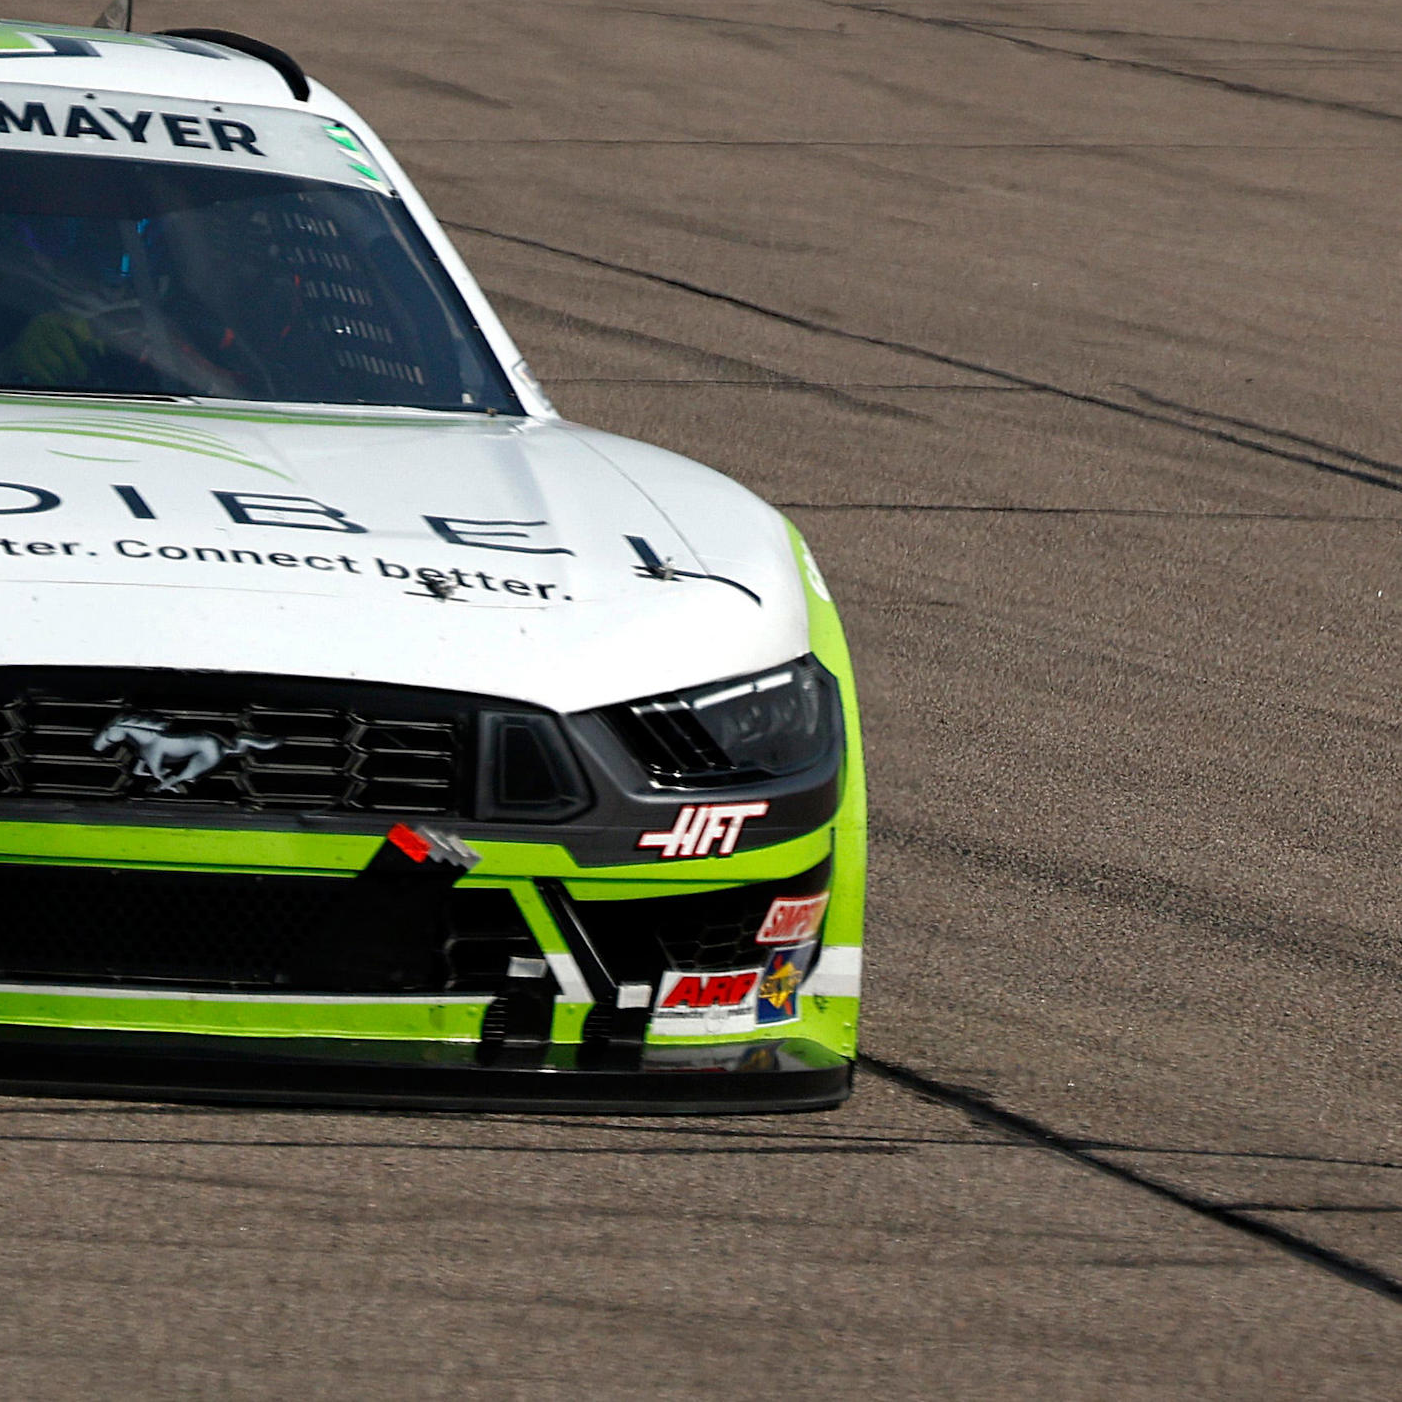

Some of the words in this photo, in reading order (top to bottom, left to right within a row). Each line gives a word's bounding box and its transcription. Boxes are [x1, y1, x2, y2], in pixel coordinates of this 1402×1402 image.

[113, 537, 362, 575] Connect
[374, 554, 574, 601] better.
[637, 802, 770, 860] HFT
[660, 971, 758, 1009] ARP
